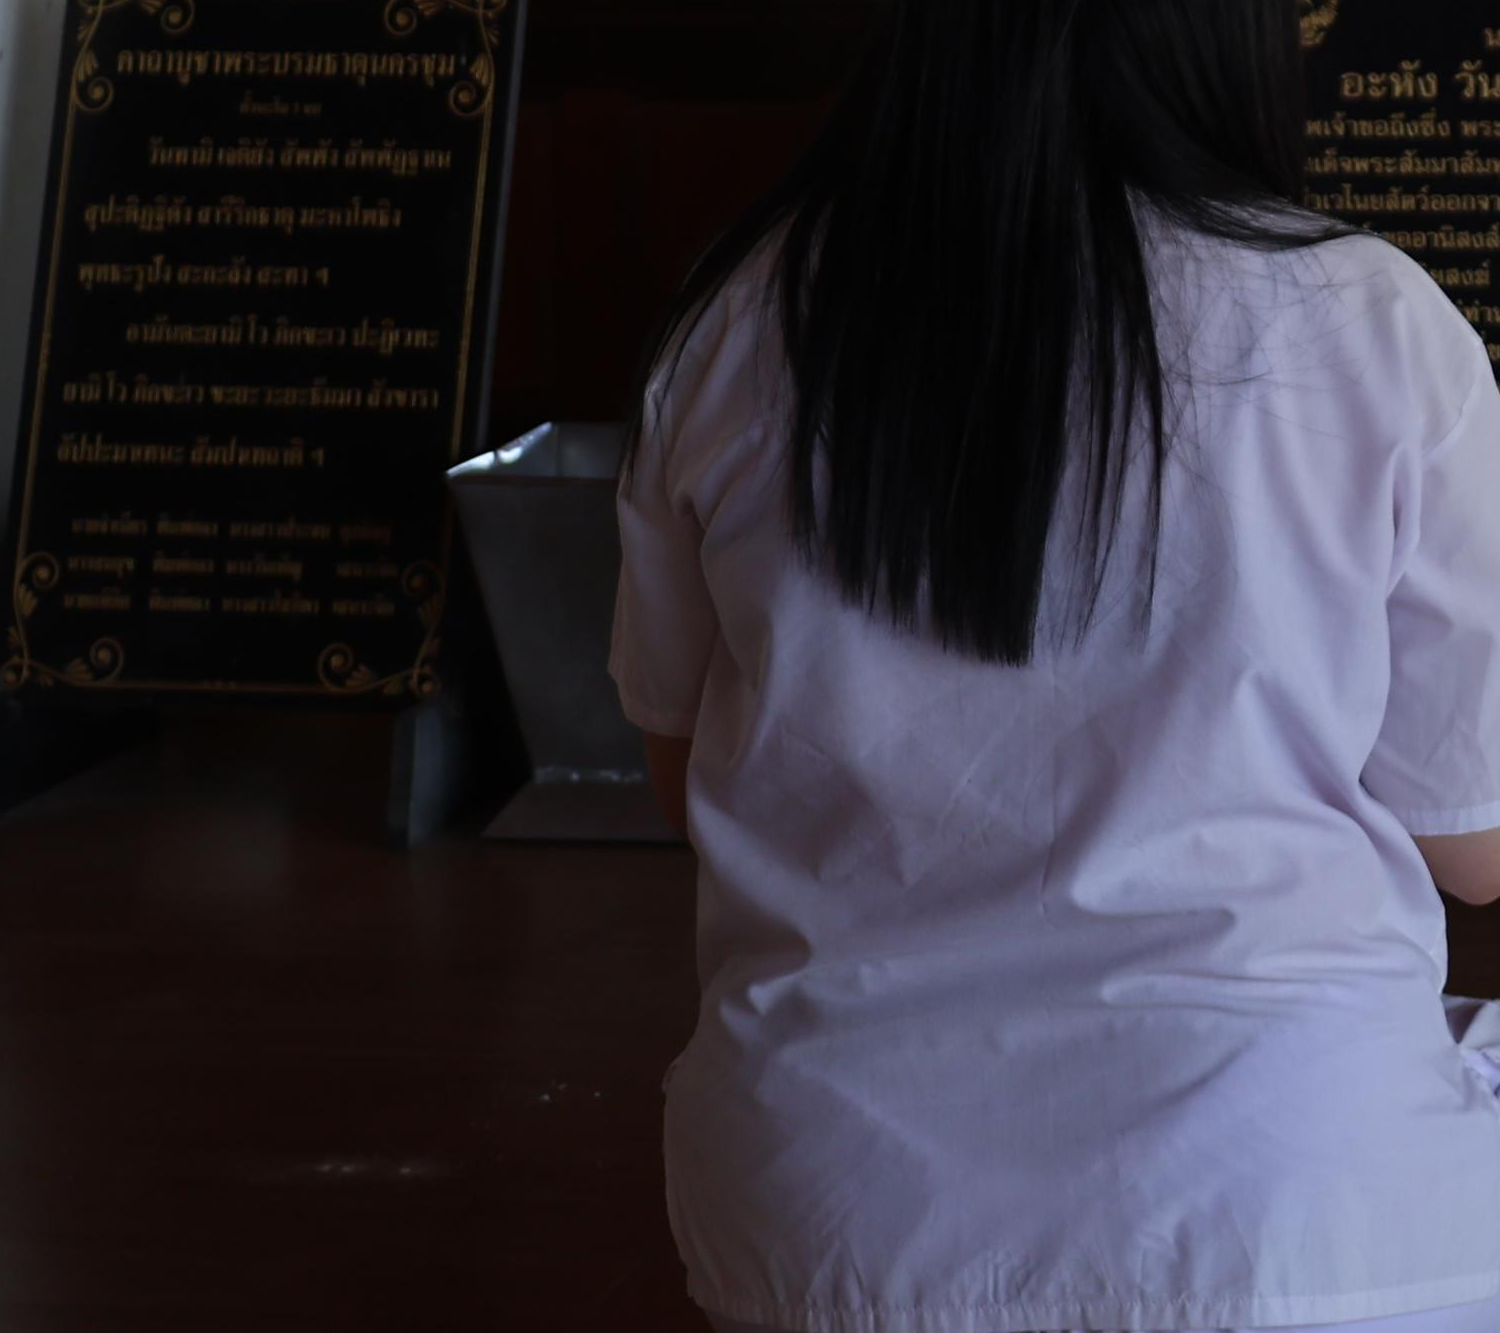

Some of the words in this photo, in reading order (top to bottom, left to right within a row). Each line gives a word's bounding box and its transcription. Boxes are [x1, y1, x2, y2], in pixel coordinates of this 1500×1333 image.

[1340, 59, 1438, 100] อะหัง
[1305, 111, 1451, 139] พเจ้าขอถึงซึ่ง
